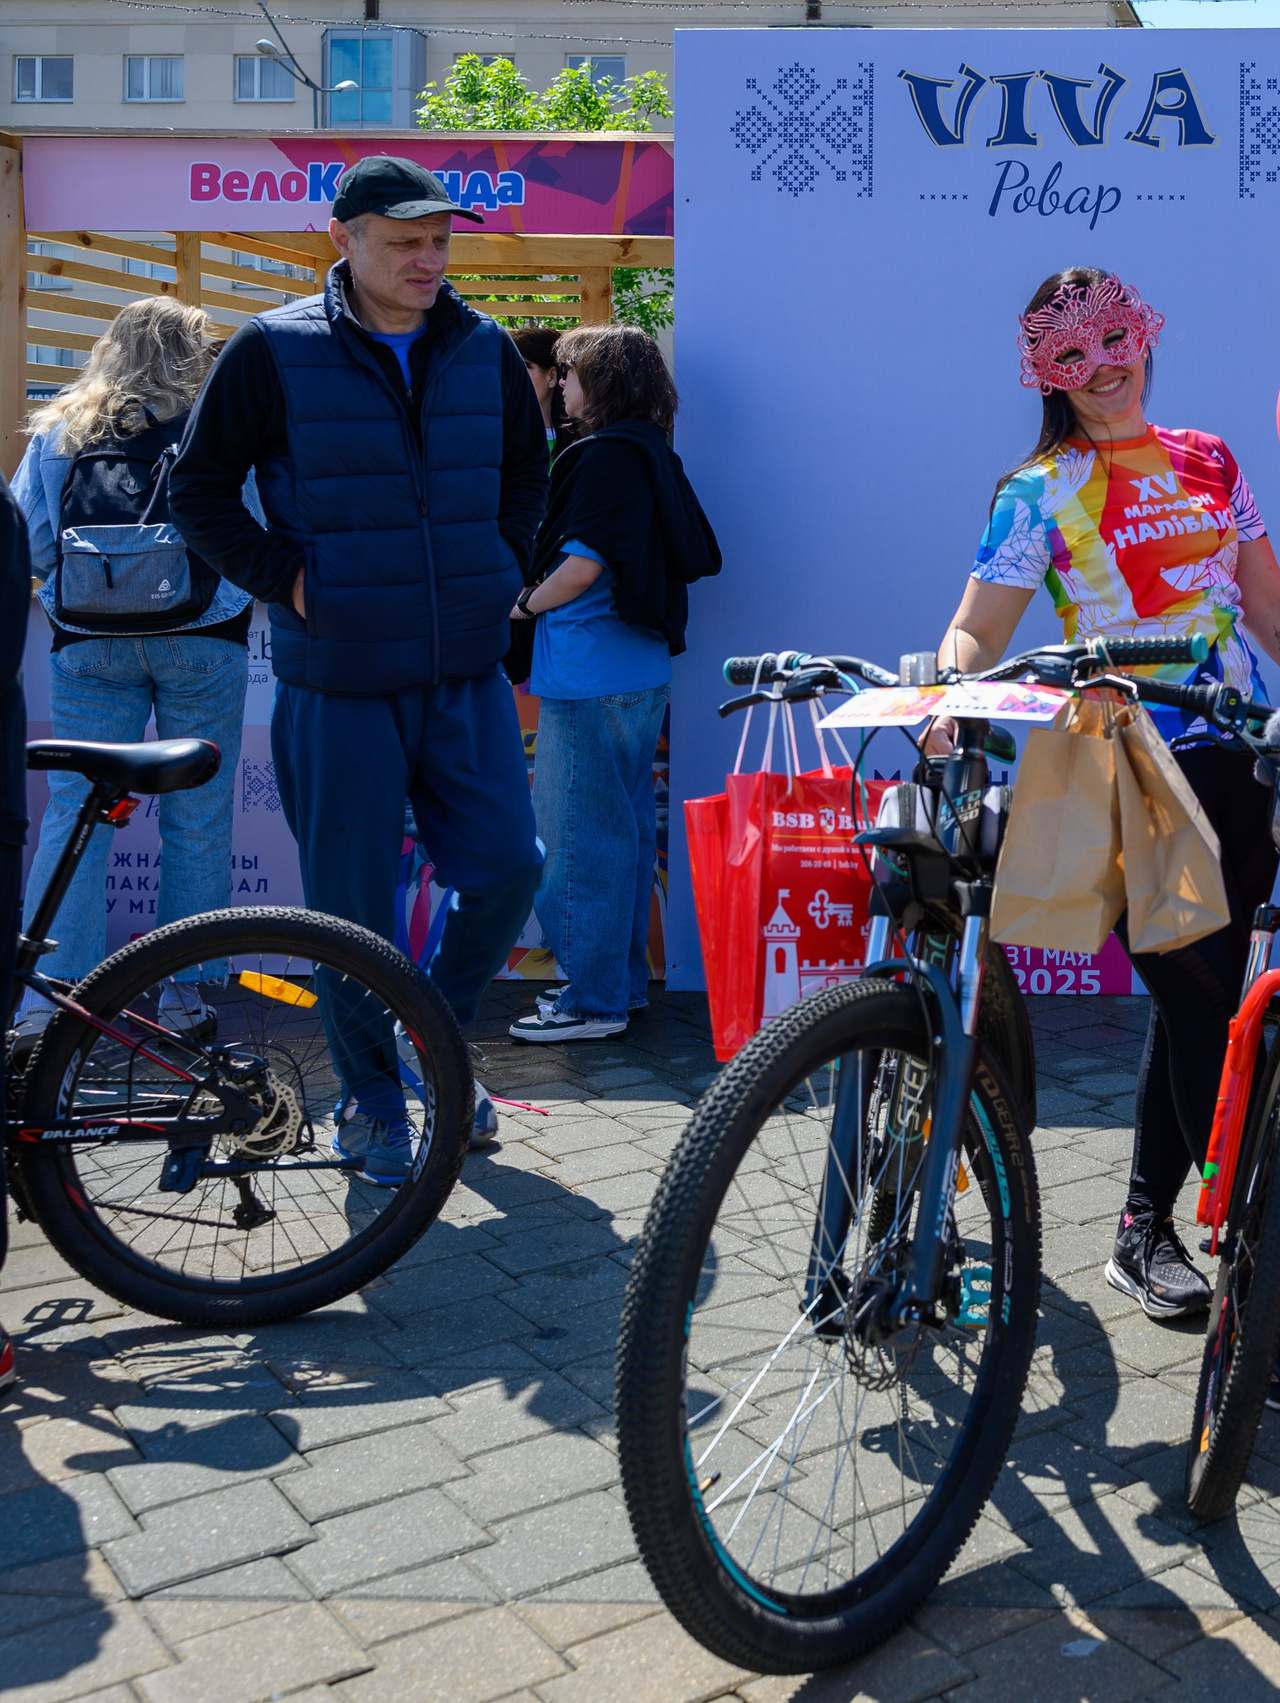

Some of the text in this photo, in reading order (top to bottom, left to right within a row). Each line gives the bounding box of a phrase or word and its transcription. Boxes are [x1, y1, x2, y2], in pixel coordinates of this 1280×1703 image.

[897, 62, 1221, 152] VIVA
[190, 162, 525, 211] ВелоКнда
[988, 160, 1122, 230] Ровар
[1129, 471, 1178, 502] XV
[772, 811, 815, 829] BSB
[1006, 946, 1092, 966] 31 МАЯ
[1013, 968, 1101, 995] 2025
[42, 1126, 120, 1139] BALANCE
